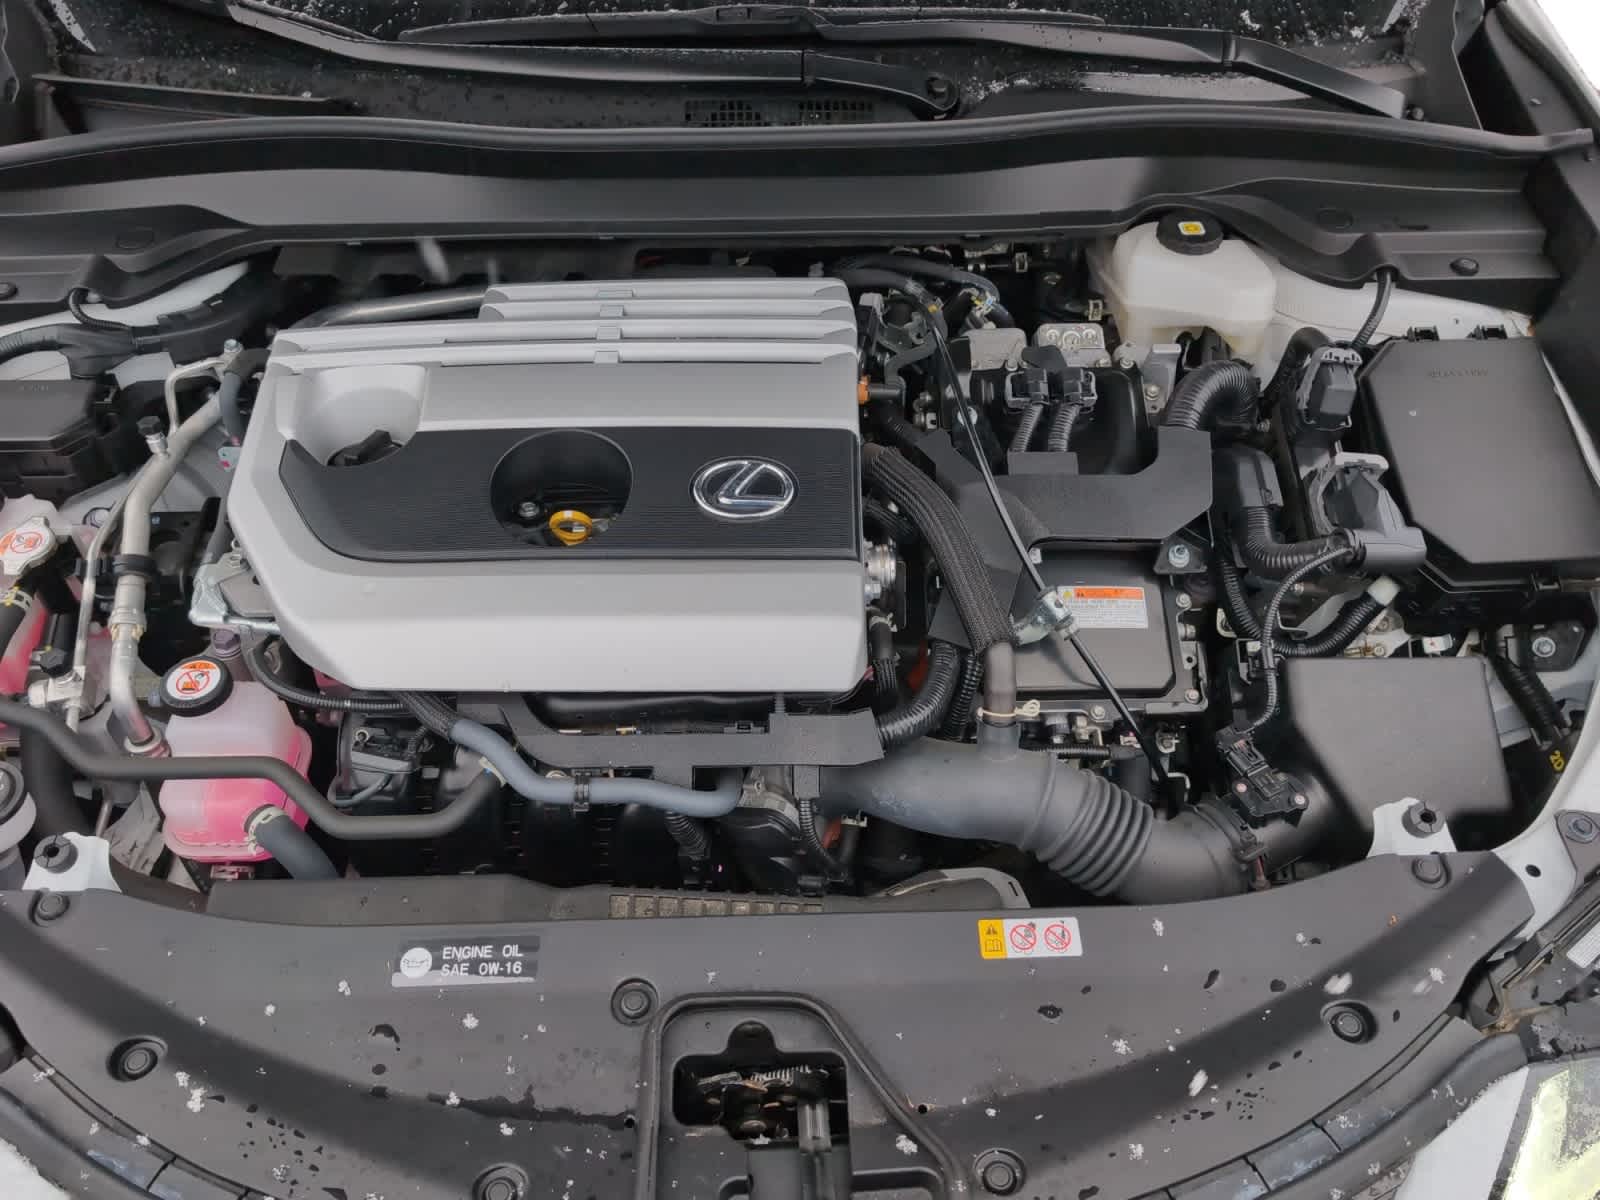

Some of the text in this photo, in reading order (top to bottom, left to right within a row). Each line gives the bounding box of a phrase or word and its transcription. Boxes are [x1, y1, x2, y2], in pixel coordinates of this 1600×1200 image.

[442, 944, 523, 960] ENGINE OIL
[441, 963, 470, 977] SAE
